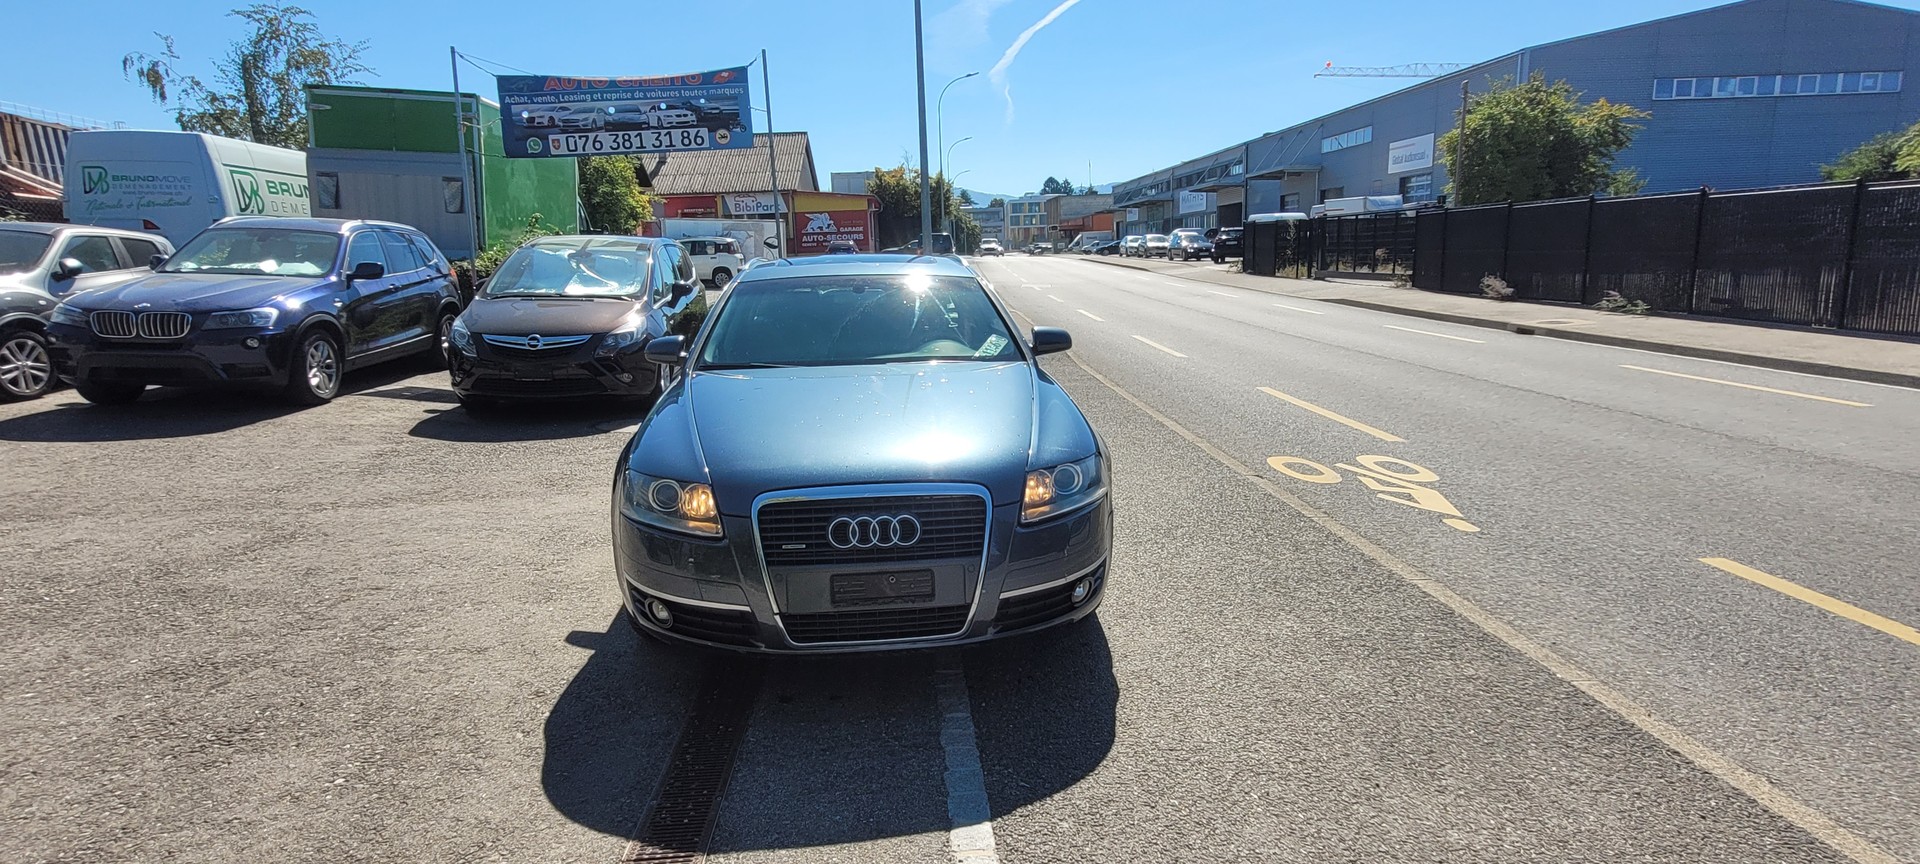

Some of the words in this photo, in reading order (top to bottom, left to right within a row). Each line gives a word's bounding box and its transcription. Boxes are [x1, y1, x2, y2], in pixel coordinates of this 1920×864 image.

[504, 95, 531, 104] Achat,
[533, 94, 559, 103] vente,
[559, 92, 591, 102] Leasing
[593, 92, 601, 100] et
[603, 90, 632, 101] reprise
[634, 90, 644, 98] de
[646, 89, 680, 98] voitures
[682, 88, 707, 97] toutes
[709, 86, 744, 97] marques
[565, 133, 604, 153] 076
[609, 132, 647, 151] 381
[651, 131, 676, 149] 31
[680, 129, 705, 147] 86
[111, 174, 191, 184] BRUNOMOVE
[801, 233, 864, 243] AUTO-SECOURS
